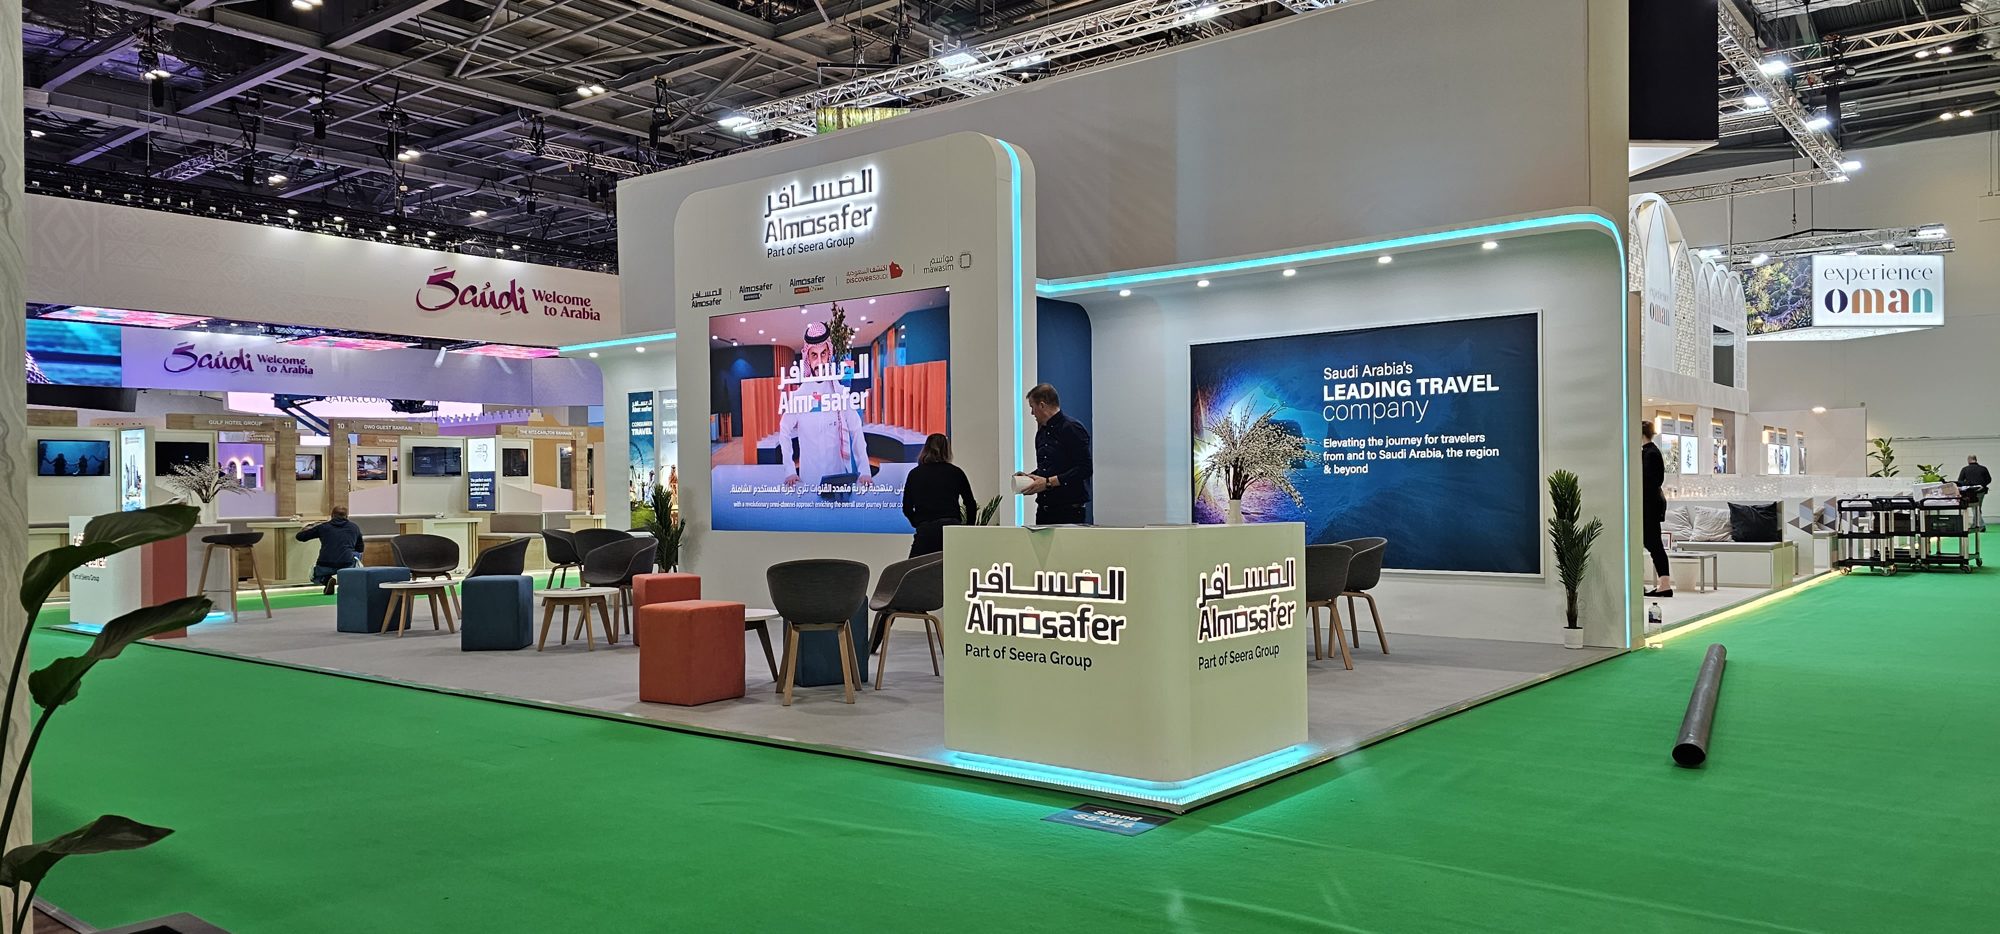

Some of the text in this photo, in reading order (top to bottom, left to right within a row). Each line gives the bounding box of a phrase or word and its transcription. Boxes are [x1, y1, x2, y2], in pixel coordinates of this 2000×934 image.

[765, 204, 872, 243] Almosafer
[767, 236, 855, 258] Part of Seera Group
[923, 264, 954, 274] mawasim
[1824, 263, 1933, 285] experience
[739, 282, 773, 294] Almosafer
[789, 274, 825, 287] Almosafer
[532, 288, 591, 307] Welcome
[691, 298, 722, 308] Almosafer
[1824, 288, 1933, 314] oman
[544, 306, 600, 321] to Arabia
[1650, 302, 1670, 326] oman
[257, 354, 306, 365] Welcome
[266, 365, 314, 375] to Arabia
[1323, 361, 1413, 380] Saudi Arabia's
[1323, 374, 1500, 401] LEADING TRAVEL
[1323, 399, 1429, 424] company
[1323, 433, 1486, 449] Elevating the journey for travelers
[1323, 446, 1500, 461] from and to Saudi Arabia, the region
[1323, 463, 1369, 476] & beyond
[967, 603, 1125, 642] Almosafer
[1199, 599, 1294, 641] Almosafer
[965, 644, 1092, 671] Part of Seera Group
[1198, 644, 1280, 670] Part of Seera Group
[1093, 810, 1143, 822] Stand
